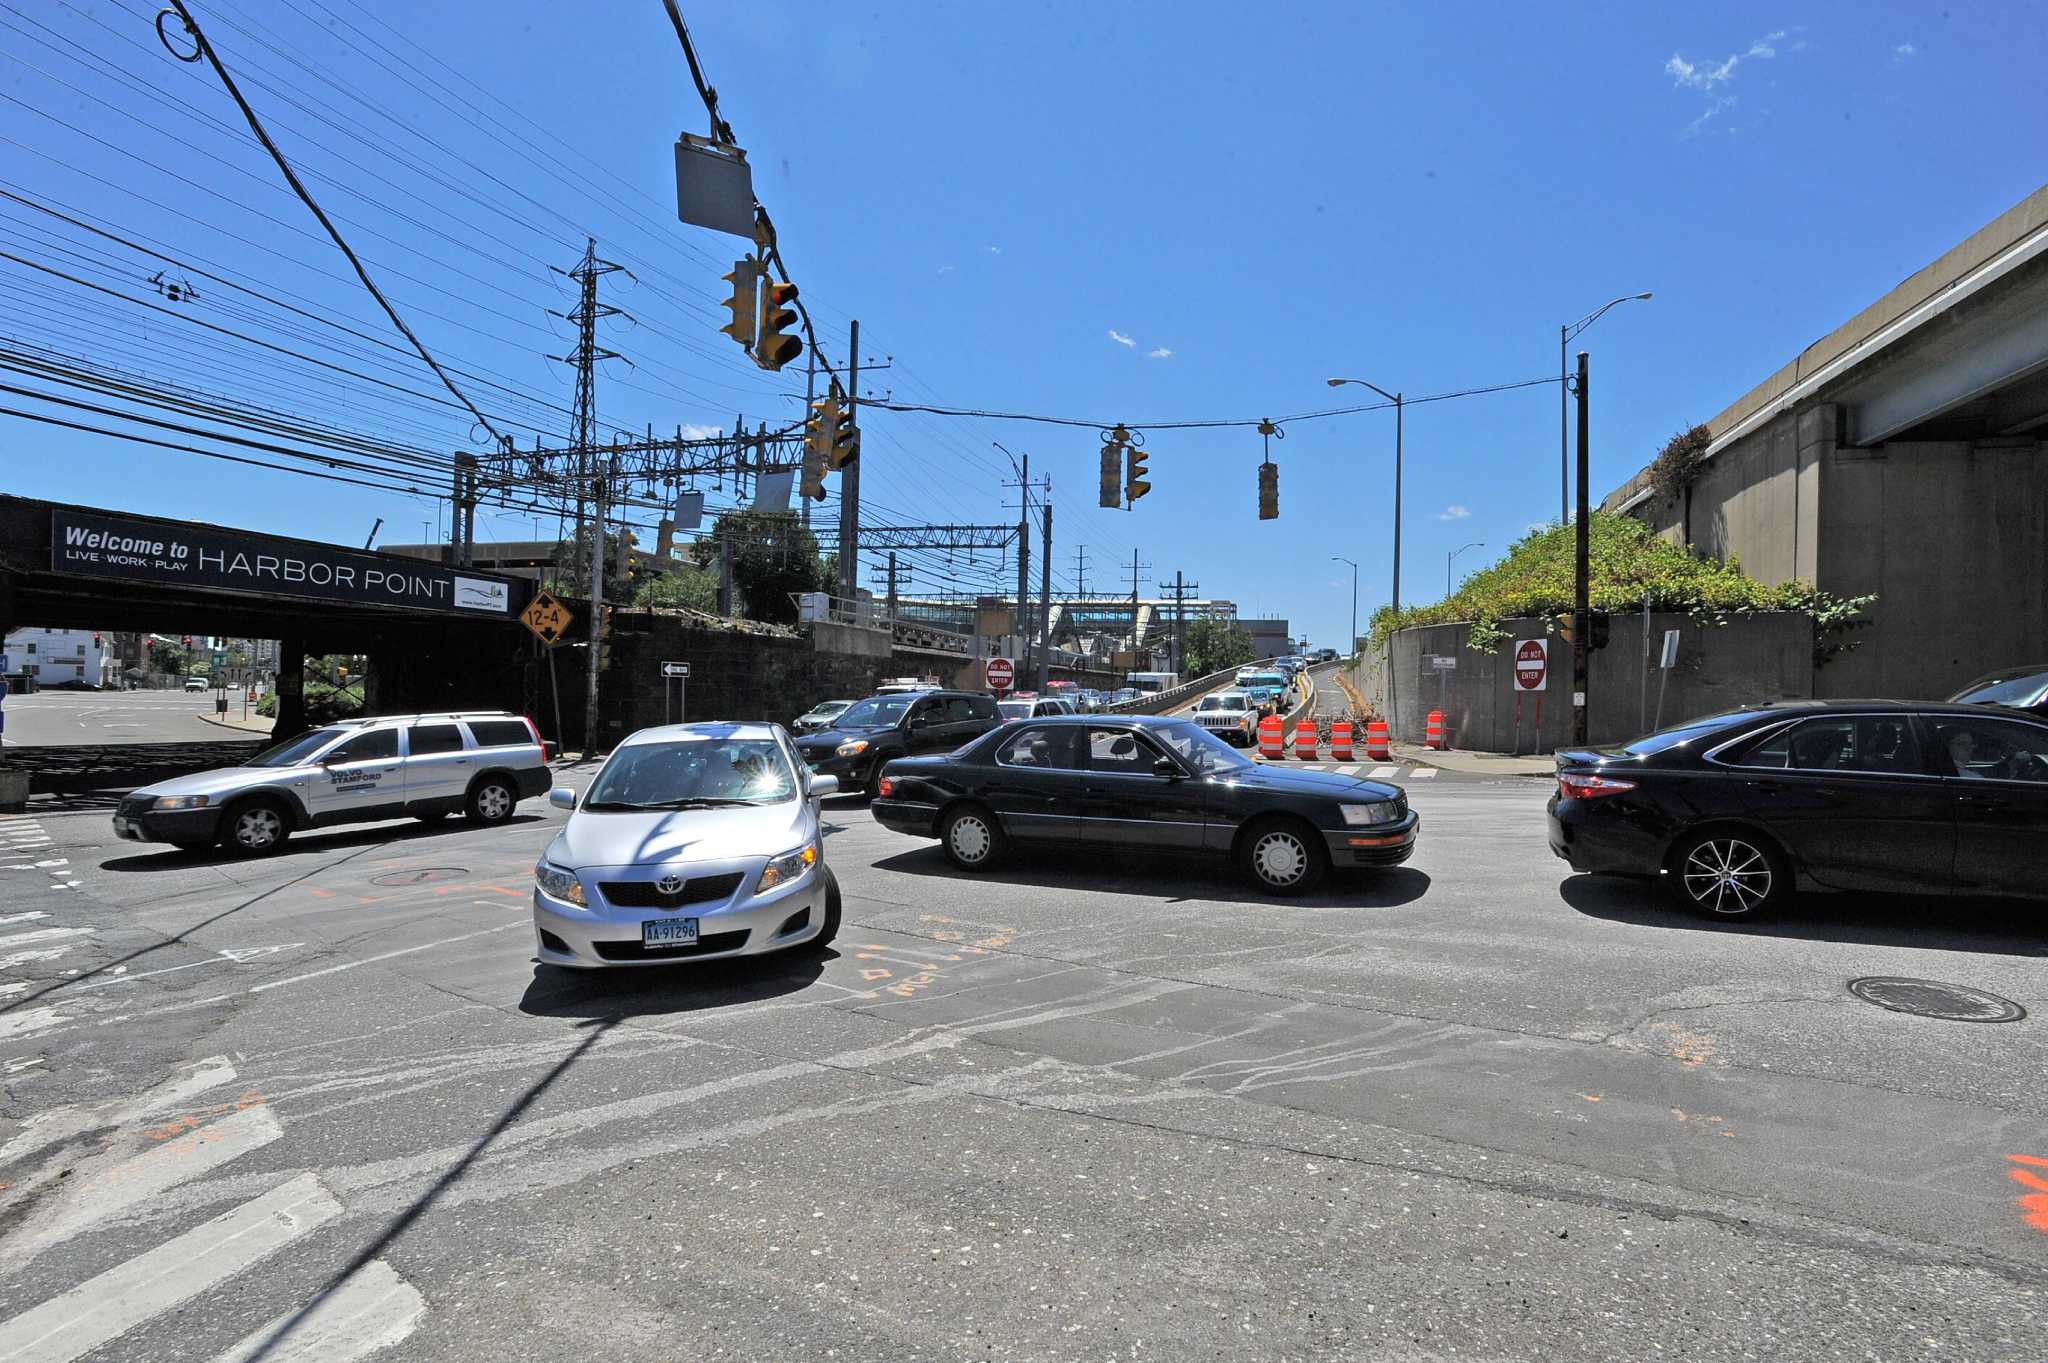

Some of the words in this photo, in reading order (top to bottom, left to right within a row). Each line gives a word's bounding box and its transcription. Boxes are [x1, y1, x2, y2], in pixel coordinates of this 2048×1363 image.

[66, 526, 164, 556] Welcome
[170, 541, 188, 559] to
[66, 549, 99, 562] LIVE
[106, 554, 148, 568] WORK
[155, 560, 188, 572] PLAY
[199, 547, 354, 588] HARBOR
[365, 570, 450, 599] POINT
[330, 769, 362, 778] VOLVO
[330, 773, 382, 784] STAMFORD
